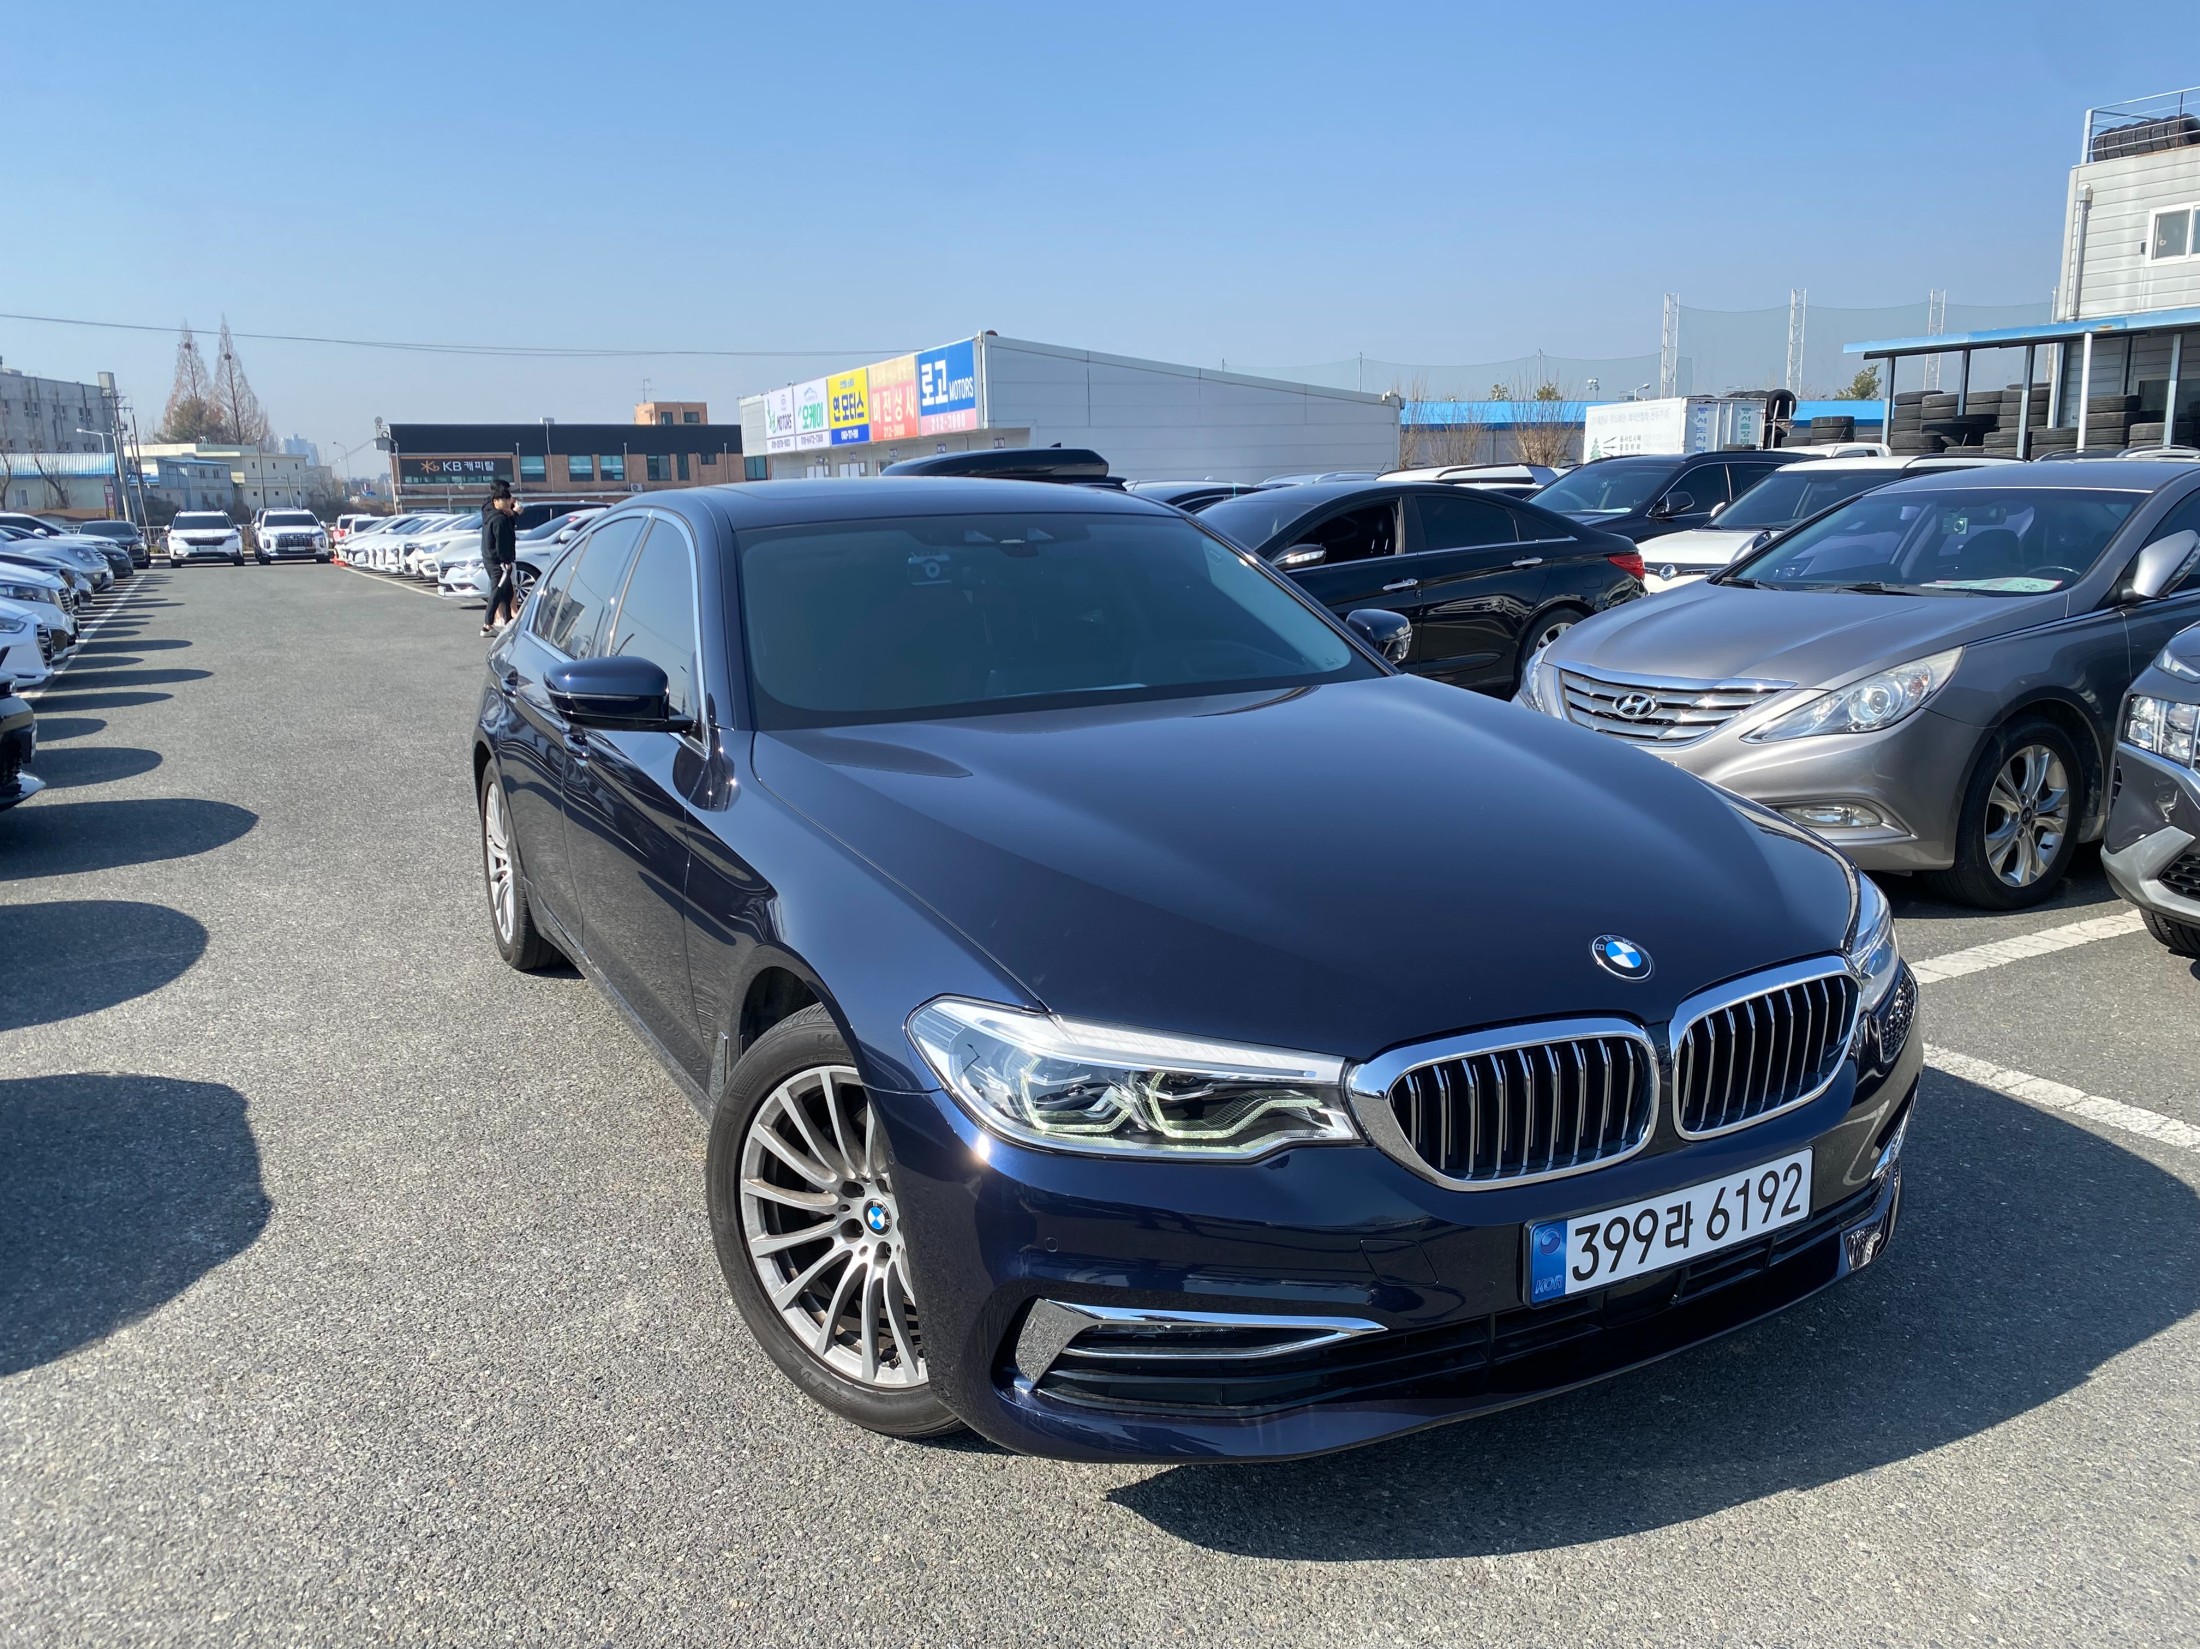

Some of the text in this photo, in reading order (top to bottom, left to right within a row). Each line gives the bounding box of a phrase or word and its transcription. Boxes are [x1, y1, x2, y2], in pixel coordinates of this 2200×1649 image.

[921, 360, 948, 406] 로고
[949, 376, 974, 402] MOTORS
[802, 401, 824, 430] 오케이
[842, 390, 865, 421] 모터스
[872, 386, 915, 423] 비전상사
[931, 413, 966, 432] 212-3000
[442, 460, 494, 472] KB 캐피탈
[1571, 1161, 1803, 1282] 399라 6192
[1534, 1273, 1563, 1294] KOR
